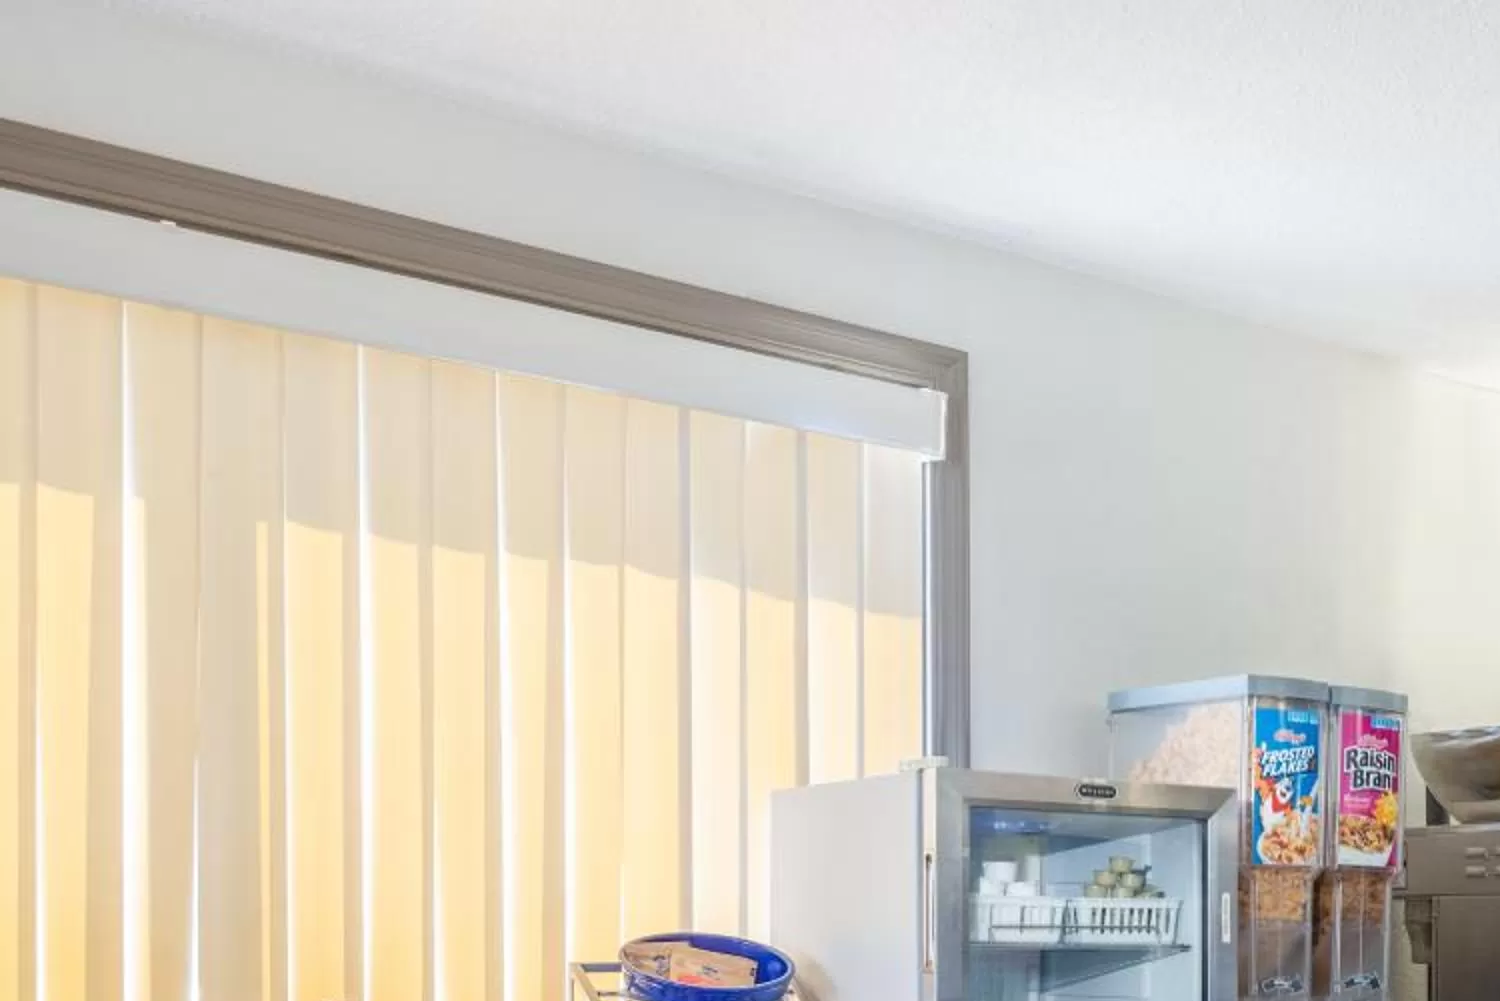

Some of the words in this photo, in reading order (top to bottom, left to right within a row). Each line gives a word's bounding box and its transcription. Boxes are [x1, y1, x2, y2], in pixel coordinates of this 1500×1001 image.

[1262, 745, 1315, 764] FROSTED
[1345, 748, 1395, 773] Raisin
[1263, 758, 1309, 777] FLAKES
[1352, 770, 1391, 789] Bran
